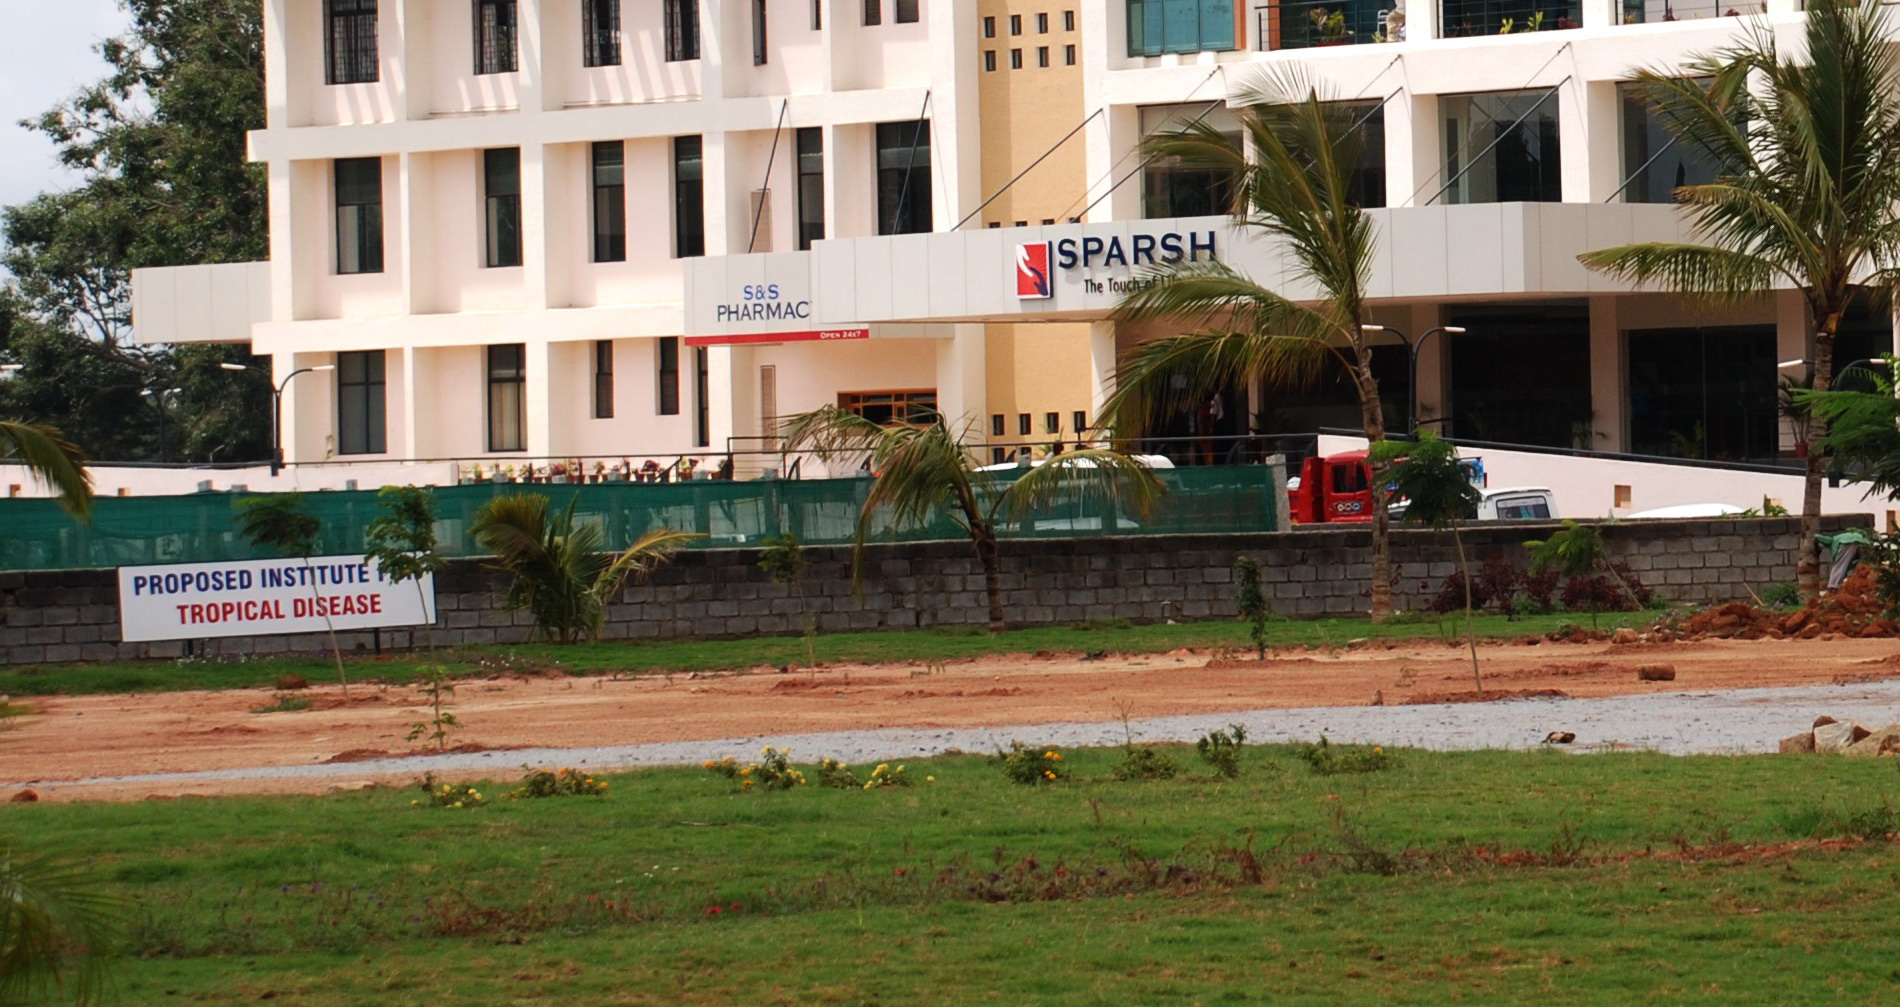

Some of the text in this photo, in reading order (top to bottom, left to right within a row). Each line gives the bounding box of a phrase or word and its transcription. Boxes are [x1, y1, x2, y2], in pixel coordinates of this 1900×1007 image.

[1057, 231, 1216, 269] SPARSH
[743, 284, 779, 301] S&S
[1085, 278, 1103, 293] The
[1108, 277, 1140, 293] Touch
[717, 300, 812, 322] PHARMAC
[133, 569, 253, 596] PROPOSED
[261, 563, 370, 588] INSTITUTE
[176, 594, 382, 624] TROPICAL DISEASE
